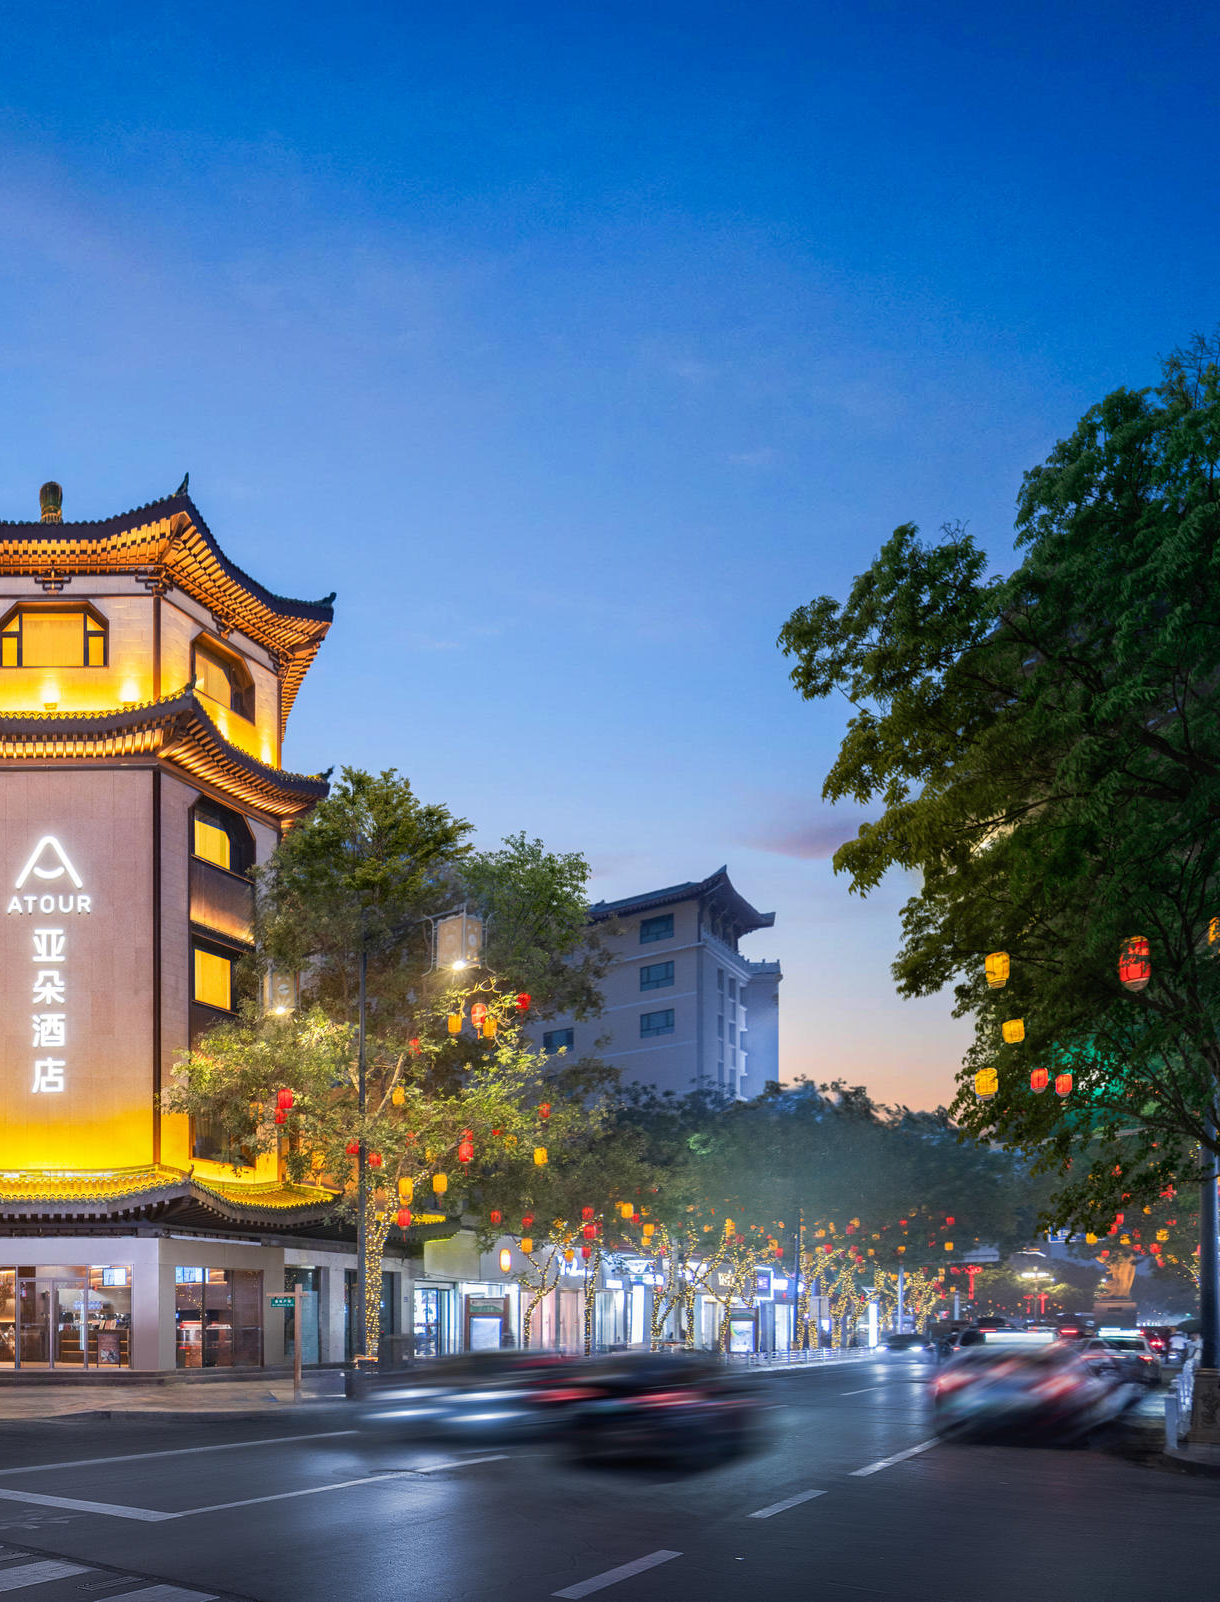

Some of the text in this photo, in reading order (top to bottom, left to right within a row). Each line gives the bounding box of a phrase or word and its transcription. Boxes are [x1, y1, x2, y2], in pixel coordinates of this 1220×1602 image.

[7, 895, 91, 913] ATOUR
[32, 929, 66, 1093] 亚朵酒店
